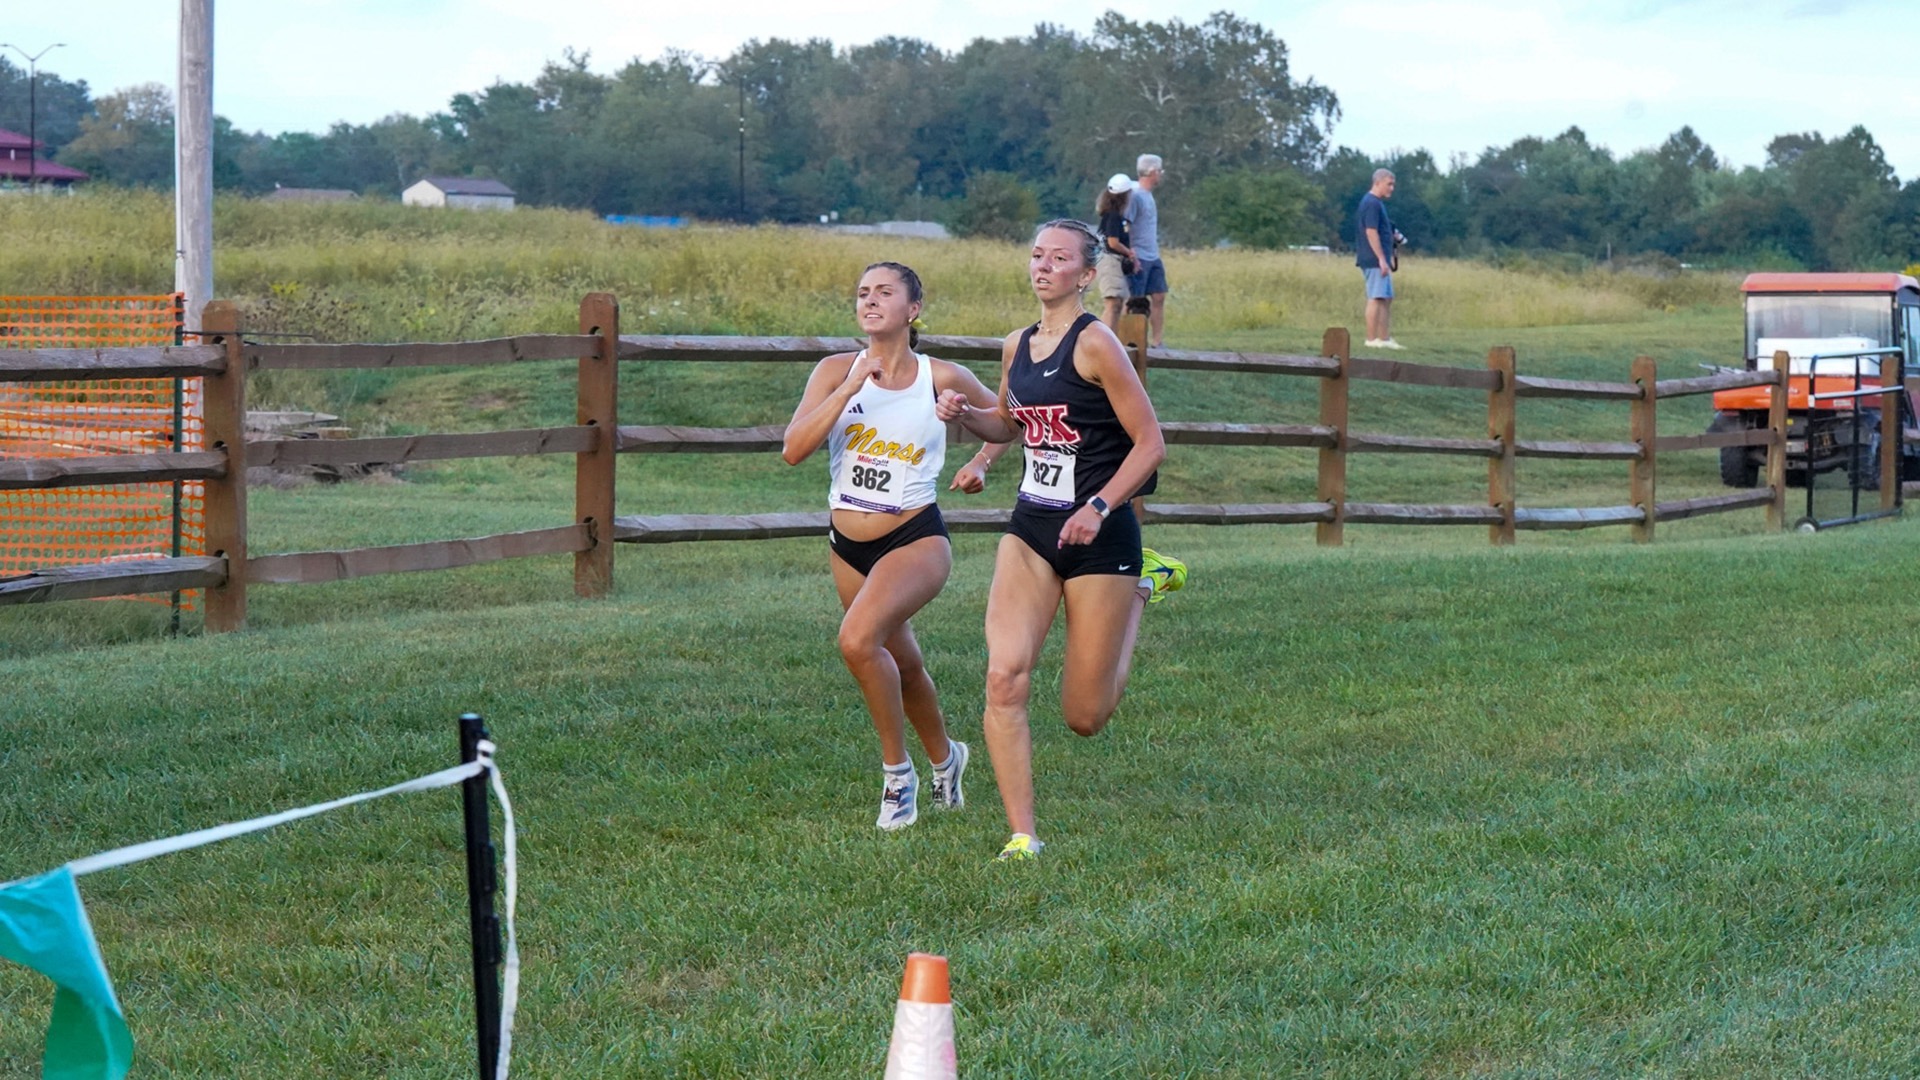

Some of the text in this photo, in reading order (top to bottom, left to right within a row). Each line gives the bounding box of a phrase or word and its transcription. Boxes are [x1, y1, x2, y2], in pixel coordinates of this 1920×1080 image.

[1009, 404, 1081, 446] UK
[845, 423, 926, 465] Norse
[852, 465, 891, 493] 362
[1033, 460, 1063, 487] 327
